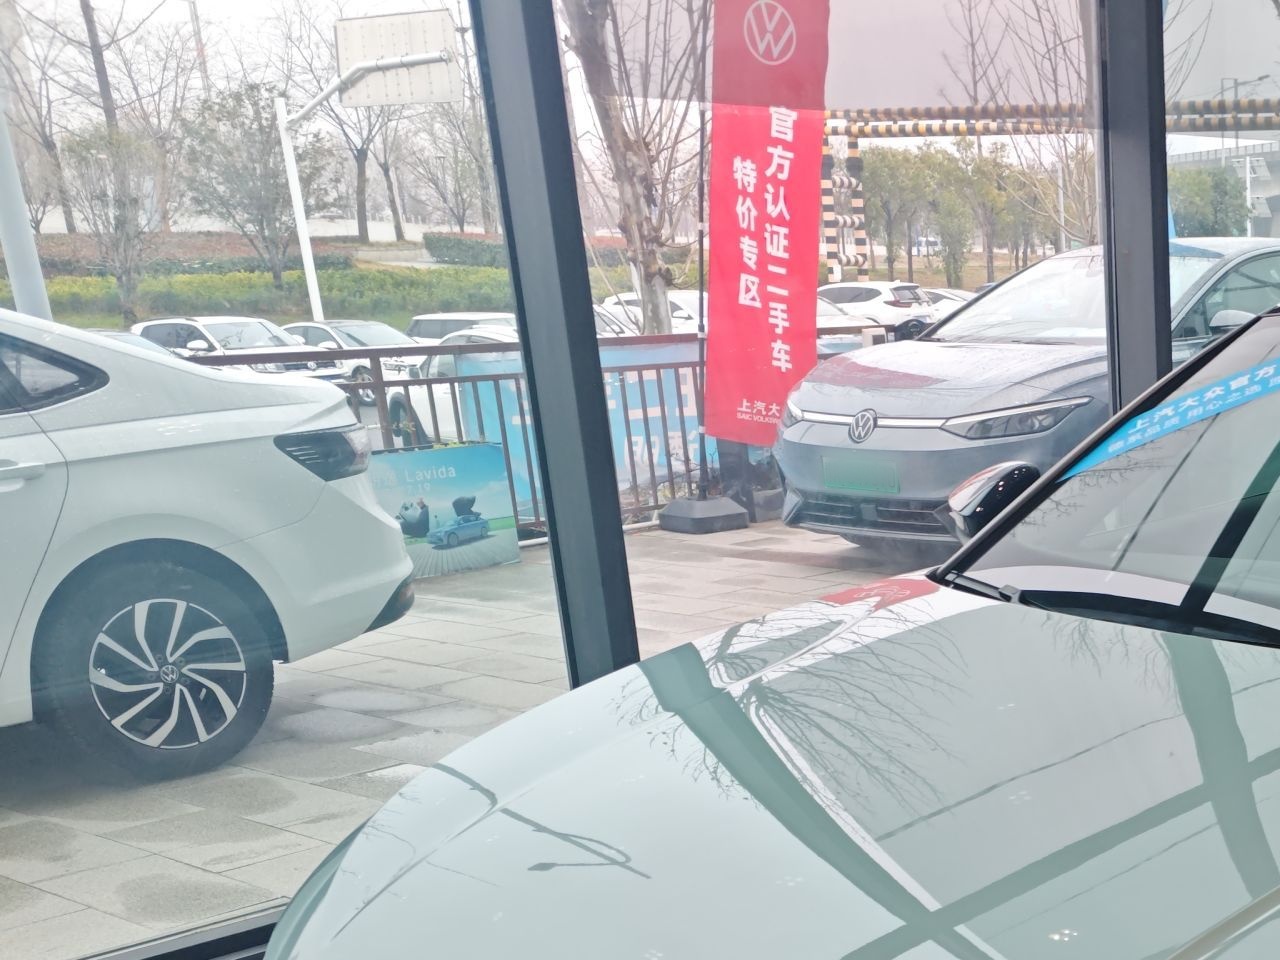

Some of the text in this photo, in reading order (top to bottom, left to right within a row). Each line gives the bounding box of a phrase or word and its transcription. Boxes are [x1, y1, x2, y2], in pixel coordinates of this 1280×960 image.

[733, 156, 762, 309] 特价专区
[764, 106, 797, 373] 官方认证二手车
[737, 398, 781, 417] 上汽大
[404, 464, 457, 482] Lavida
